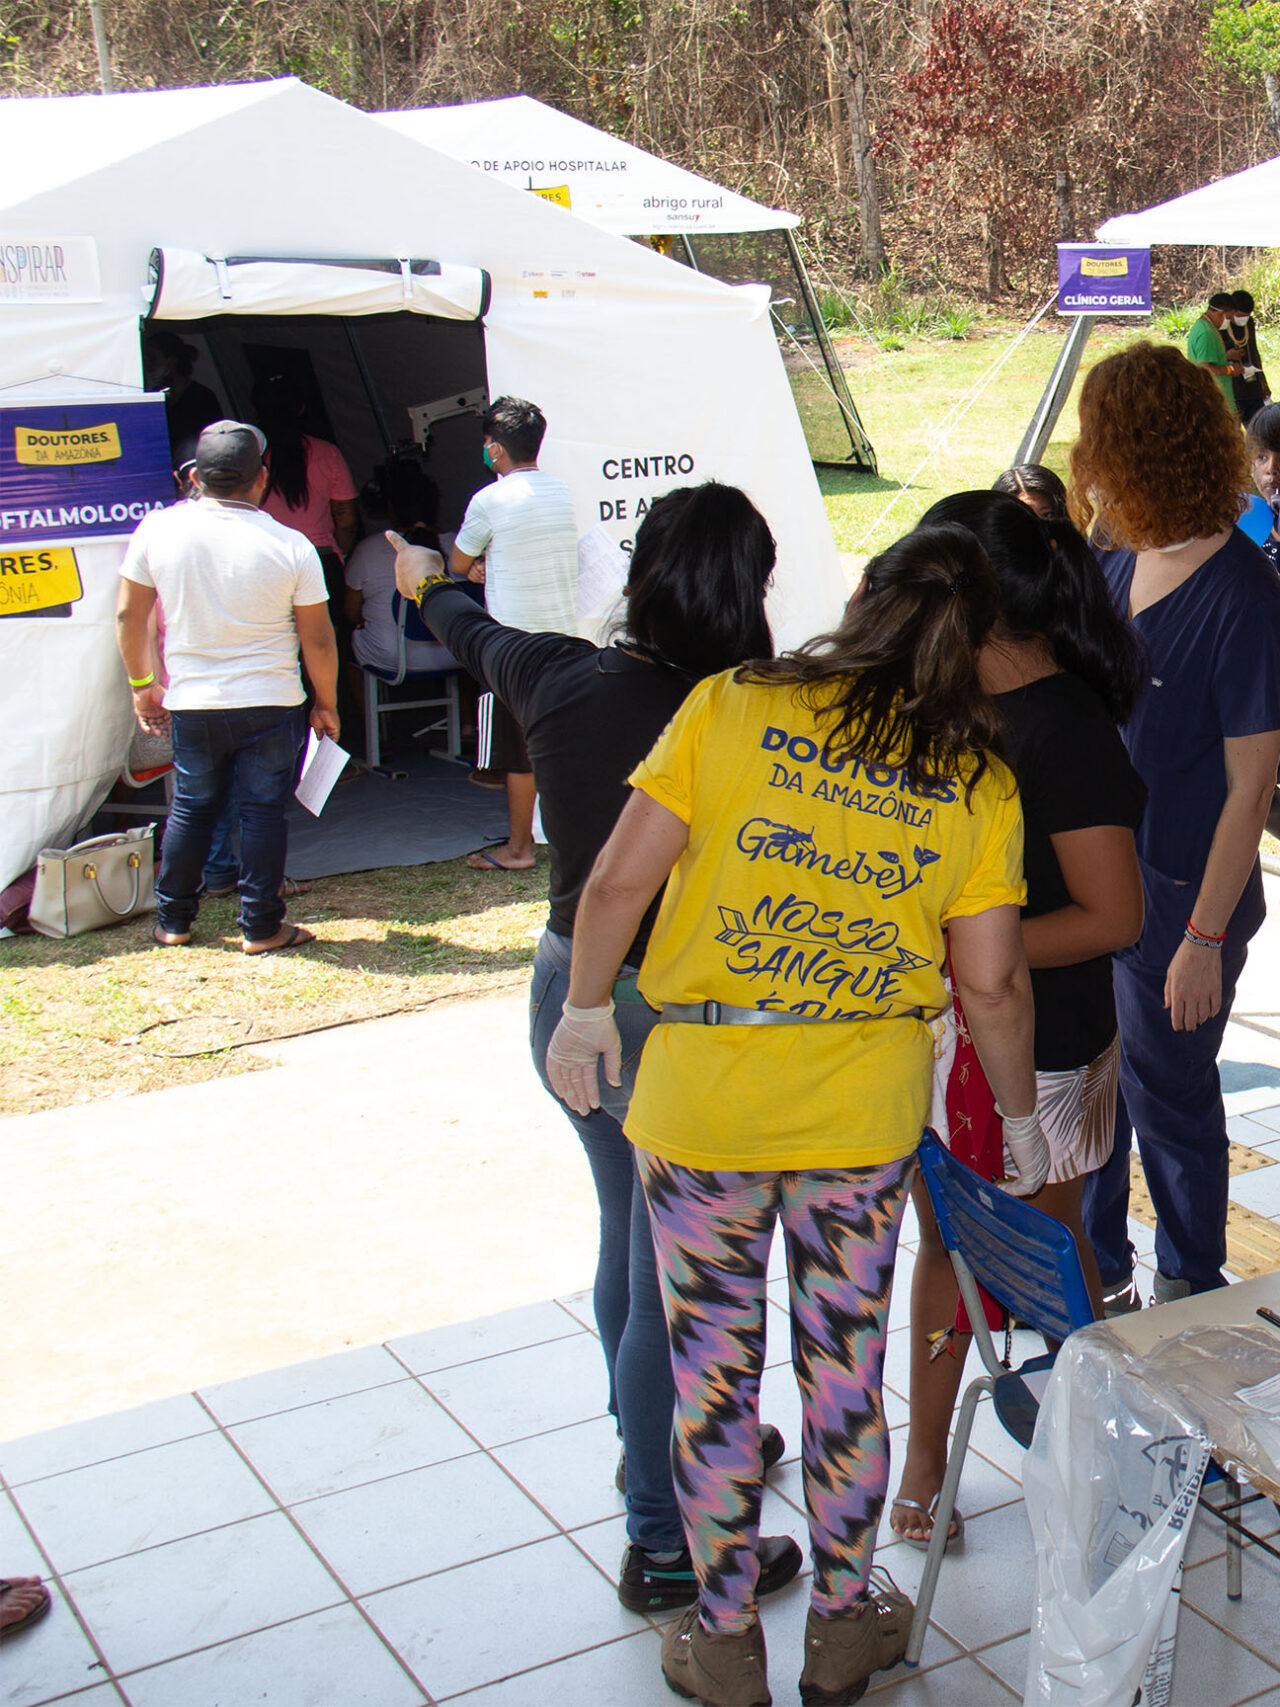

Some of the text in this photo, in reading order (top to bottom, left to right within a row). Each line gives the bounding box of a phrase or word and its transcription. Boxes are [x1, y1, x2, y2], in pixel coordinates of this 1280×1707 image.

[483, 160, 499, 171] DE
[503, 160, 545, 171] APOIO
[549, 160, 627, 171] HOSPITALAR
[643, 195, 723, 210] abrigo rural
[1064, 294, 1145, 305] CLÍNICO GERAL
[602, 453, 694, 480] CENTRO
[599, 500, 627, 521] DE
[769, 763, 932, 828] DA AMAZÔNIA
[752, 893, 899, 952] NOSSO
[726, 940, 910, 1004] SANGUE
